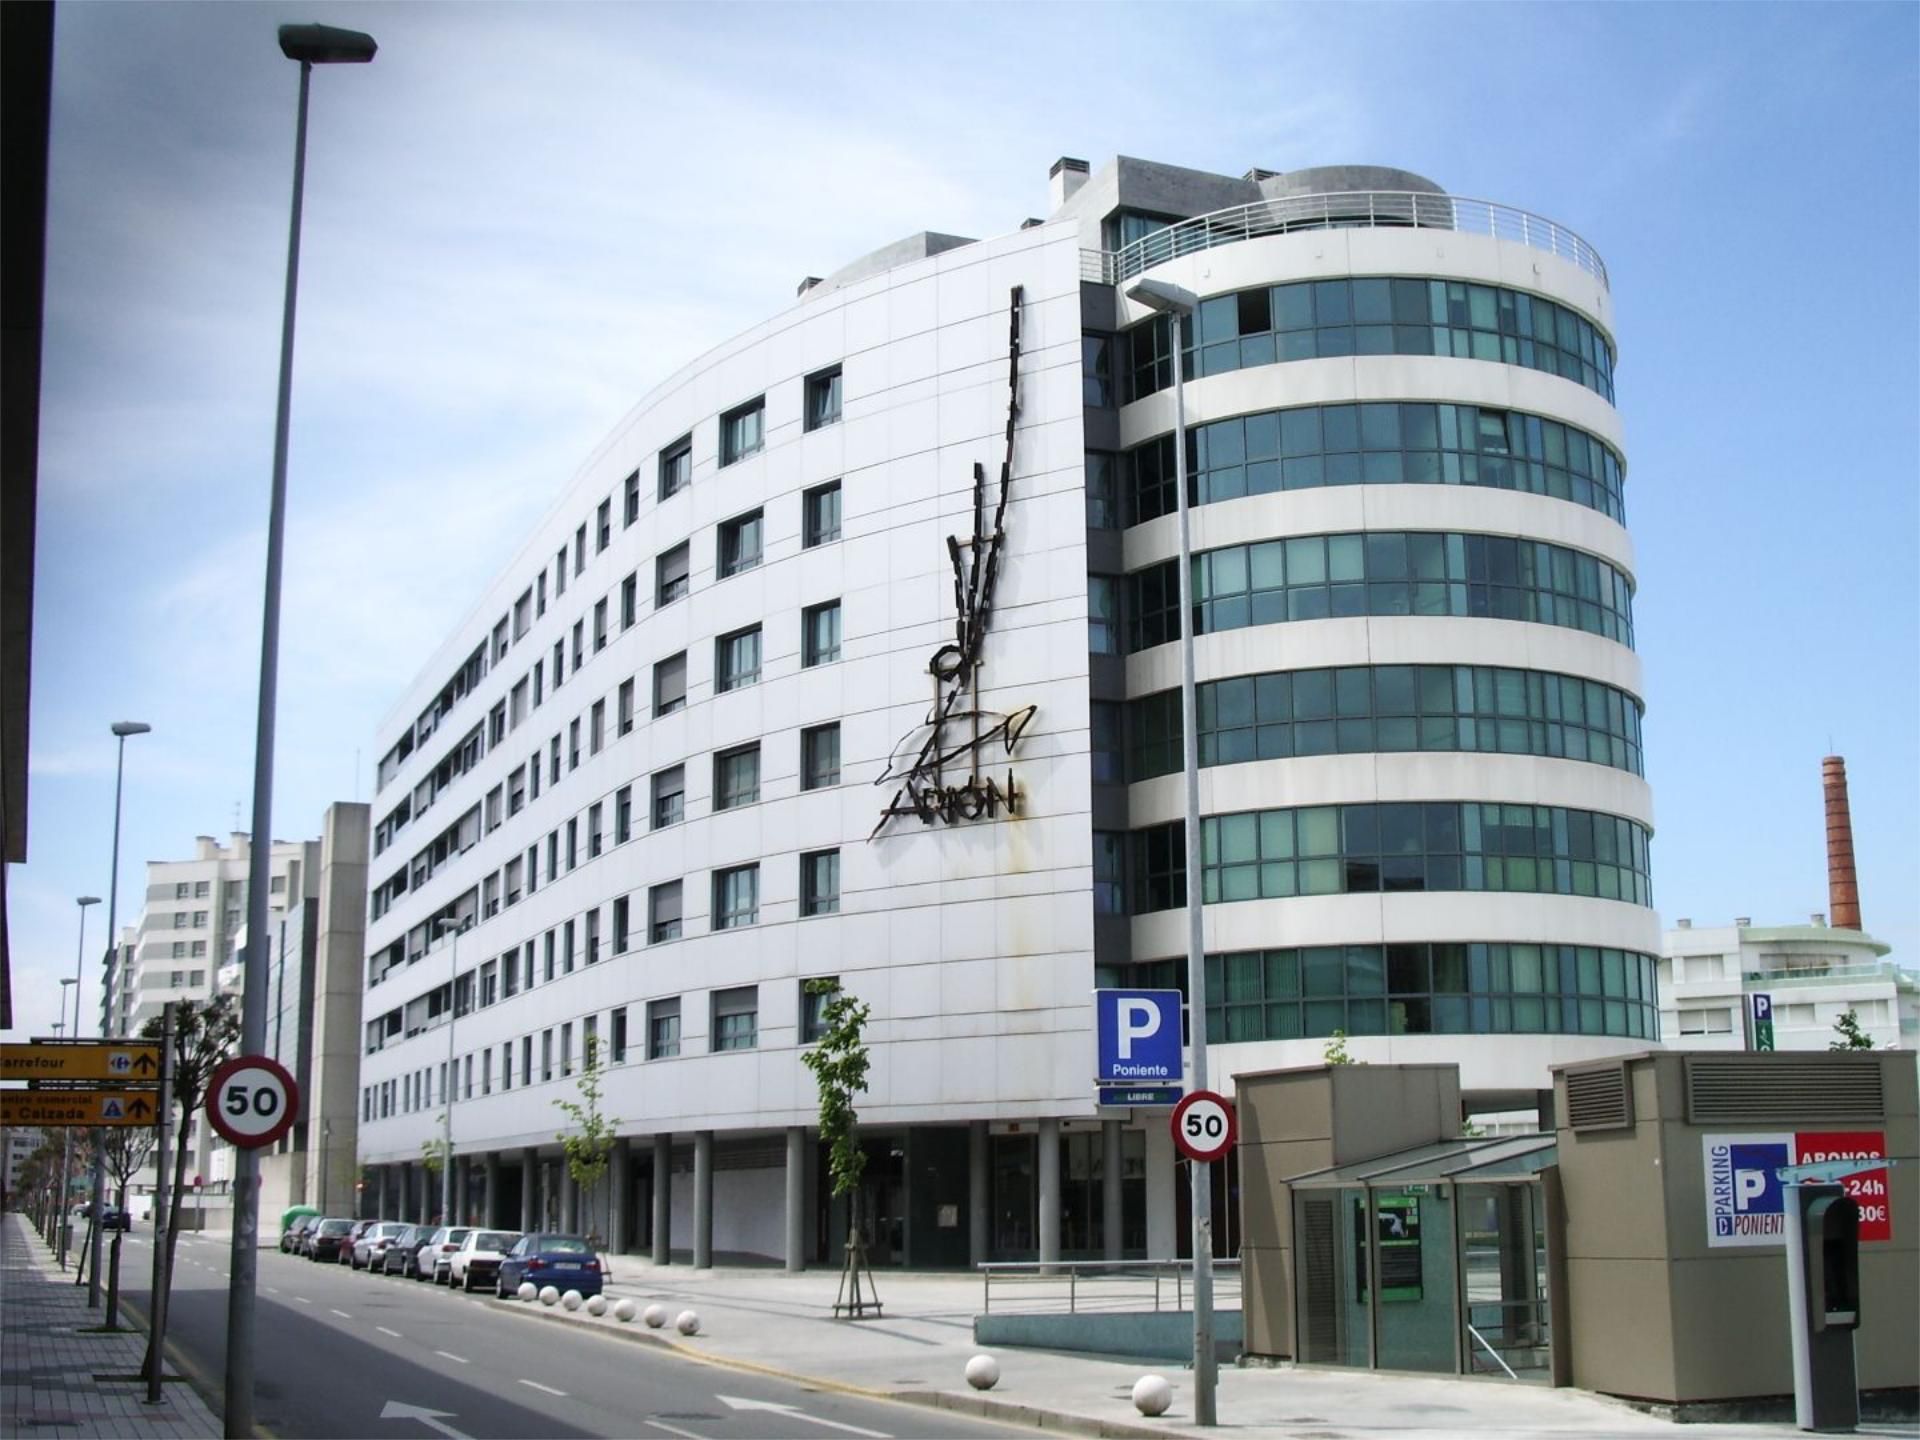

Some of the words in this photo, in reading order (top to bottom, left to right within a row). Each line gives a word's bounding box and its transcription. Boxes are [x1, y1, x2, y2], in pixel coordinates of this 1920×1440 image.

[1756, 997, 1768, 1017] P
[1117, 998, 1161, 1059] P
[0, 1056, 65, 1068] arrefour
[1113, 1064, 1168, 1076] Poniente
[226, 1086, 279, 1117] 50
[1127, 1092, 1154, 1101] LIBRE
[18, 1106, 85, 1120] Calzada
[1186, 1114, 1223, 1138] 50
[1711, 1145, 1732, 1216] PARKING
[1734, 1168, 1767, 1210] P
[1734, 1213, 1785, 1236] PONIENT
